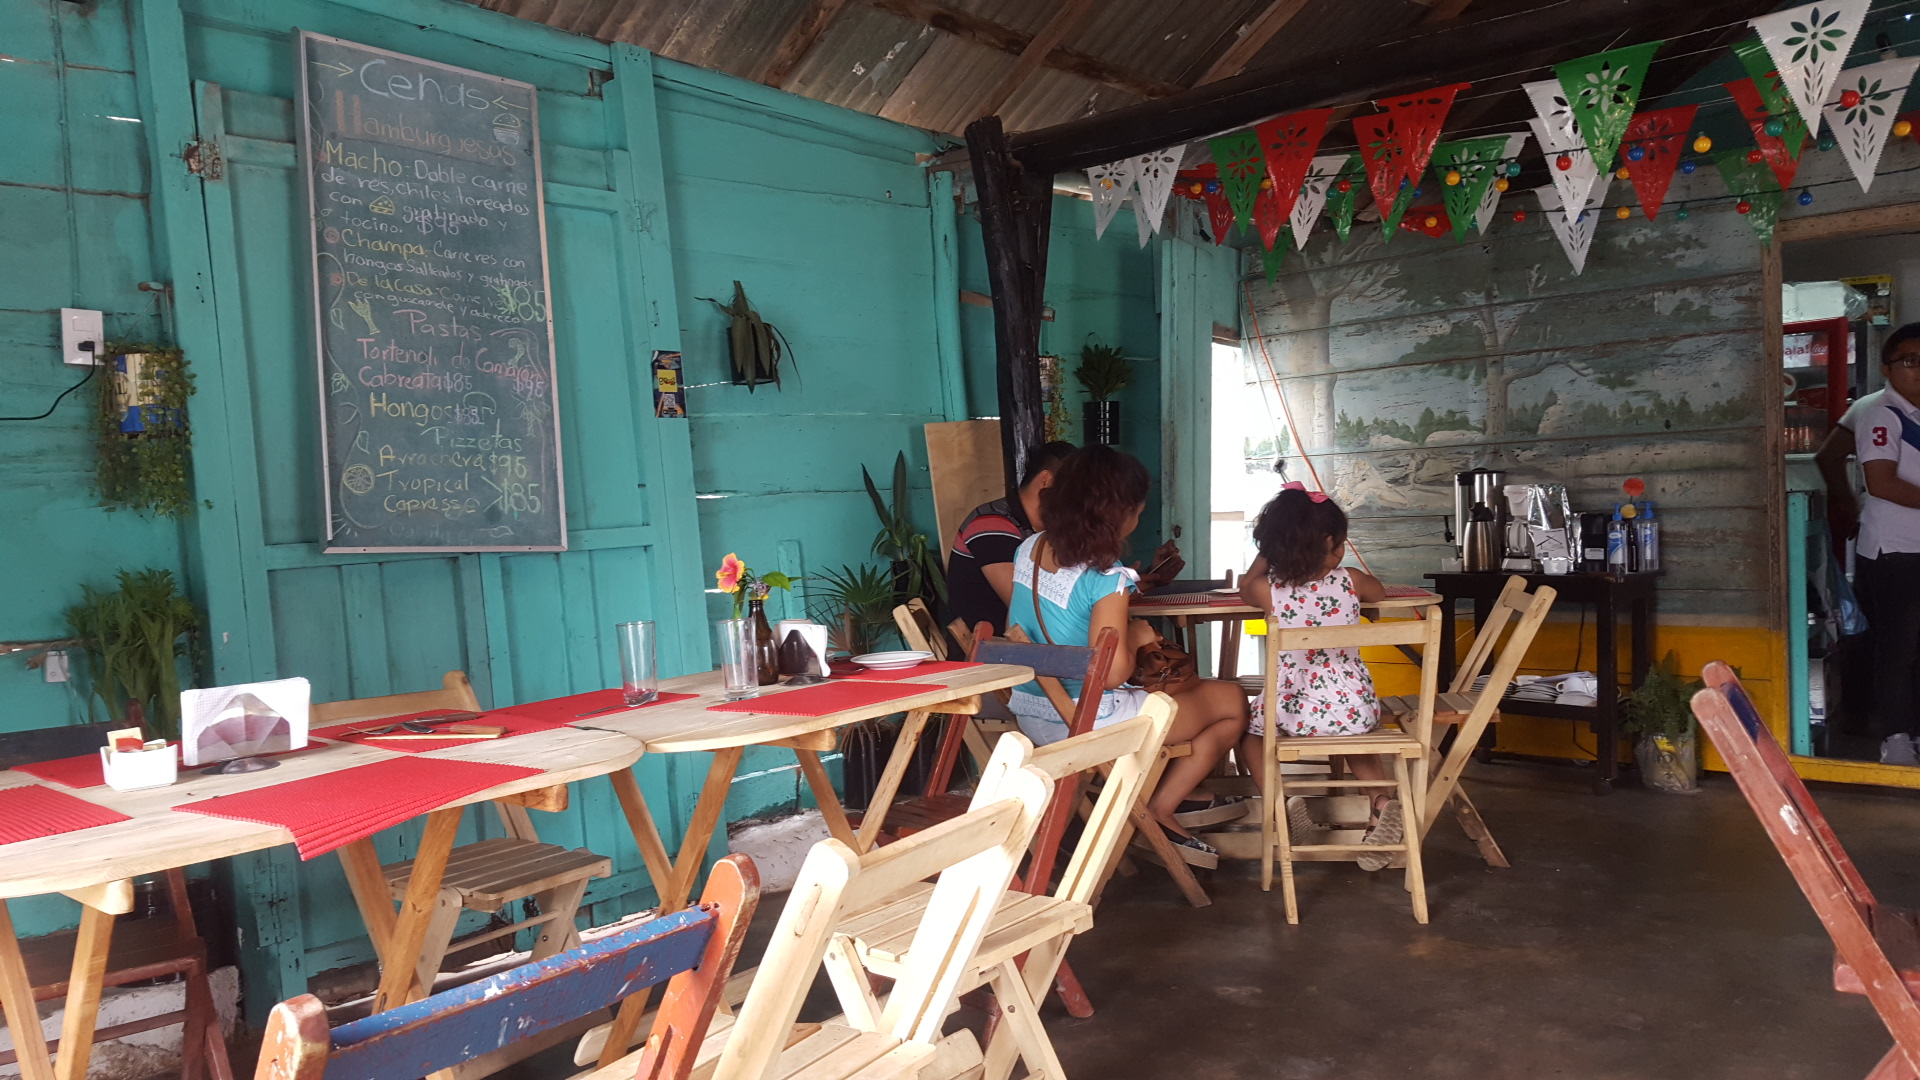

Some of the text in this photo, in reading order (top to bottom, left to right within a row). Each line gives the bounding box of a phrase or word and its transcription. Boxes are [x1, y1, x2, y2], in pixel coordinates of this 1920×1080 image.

[359, 58, 490, 110] Cenas
[321, 166, 346, 185] de
[395, 181, 452, 205] chiles
[414, 159, 466, 184] Doble
[471, 175, 528, 197] carne
[329, 191, 363, 207] con
[343, 249, 404, 275] hongos
[467, 272, 475, 283] y
[433, 239, 473, 264] Carne
[474, 252, 498, 266] res
[502, 256, 526, 269] con
[346, 271, 368, 287] De
[374, 275, 392, 291] la
[392, 308, 483, 342] Pastas
[459, 305, 467, 317] y
[470, 306, 521, 324] aderezo
[451, 340, 471, 369] de
[443, 371, 473, 394] $85
[370, 391, 453, 427] Hongos
[420, 417, 523, 453] Pizzetas
[1872, 426, 1888, 447] 3
[379, 444, 529, 479] Arrachera $95
[375, 469, 542, 515] Tropical $85
